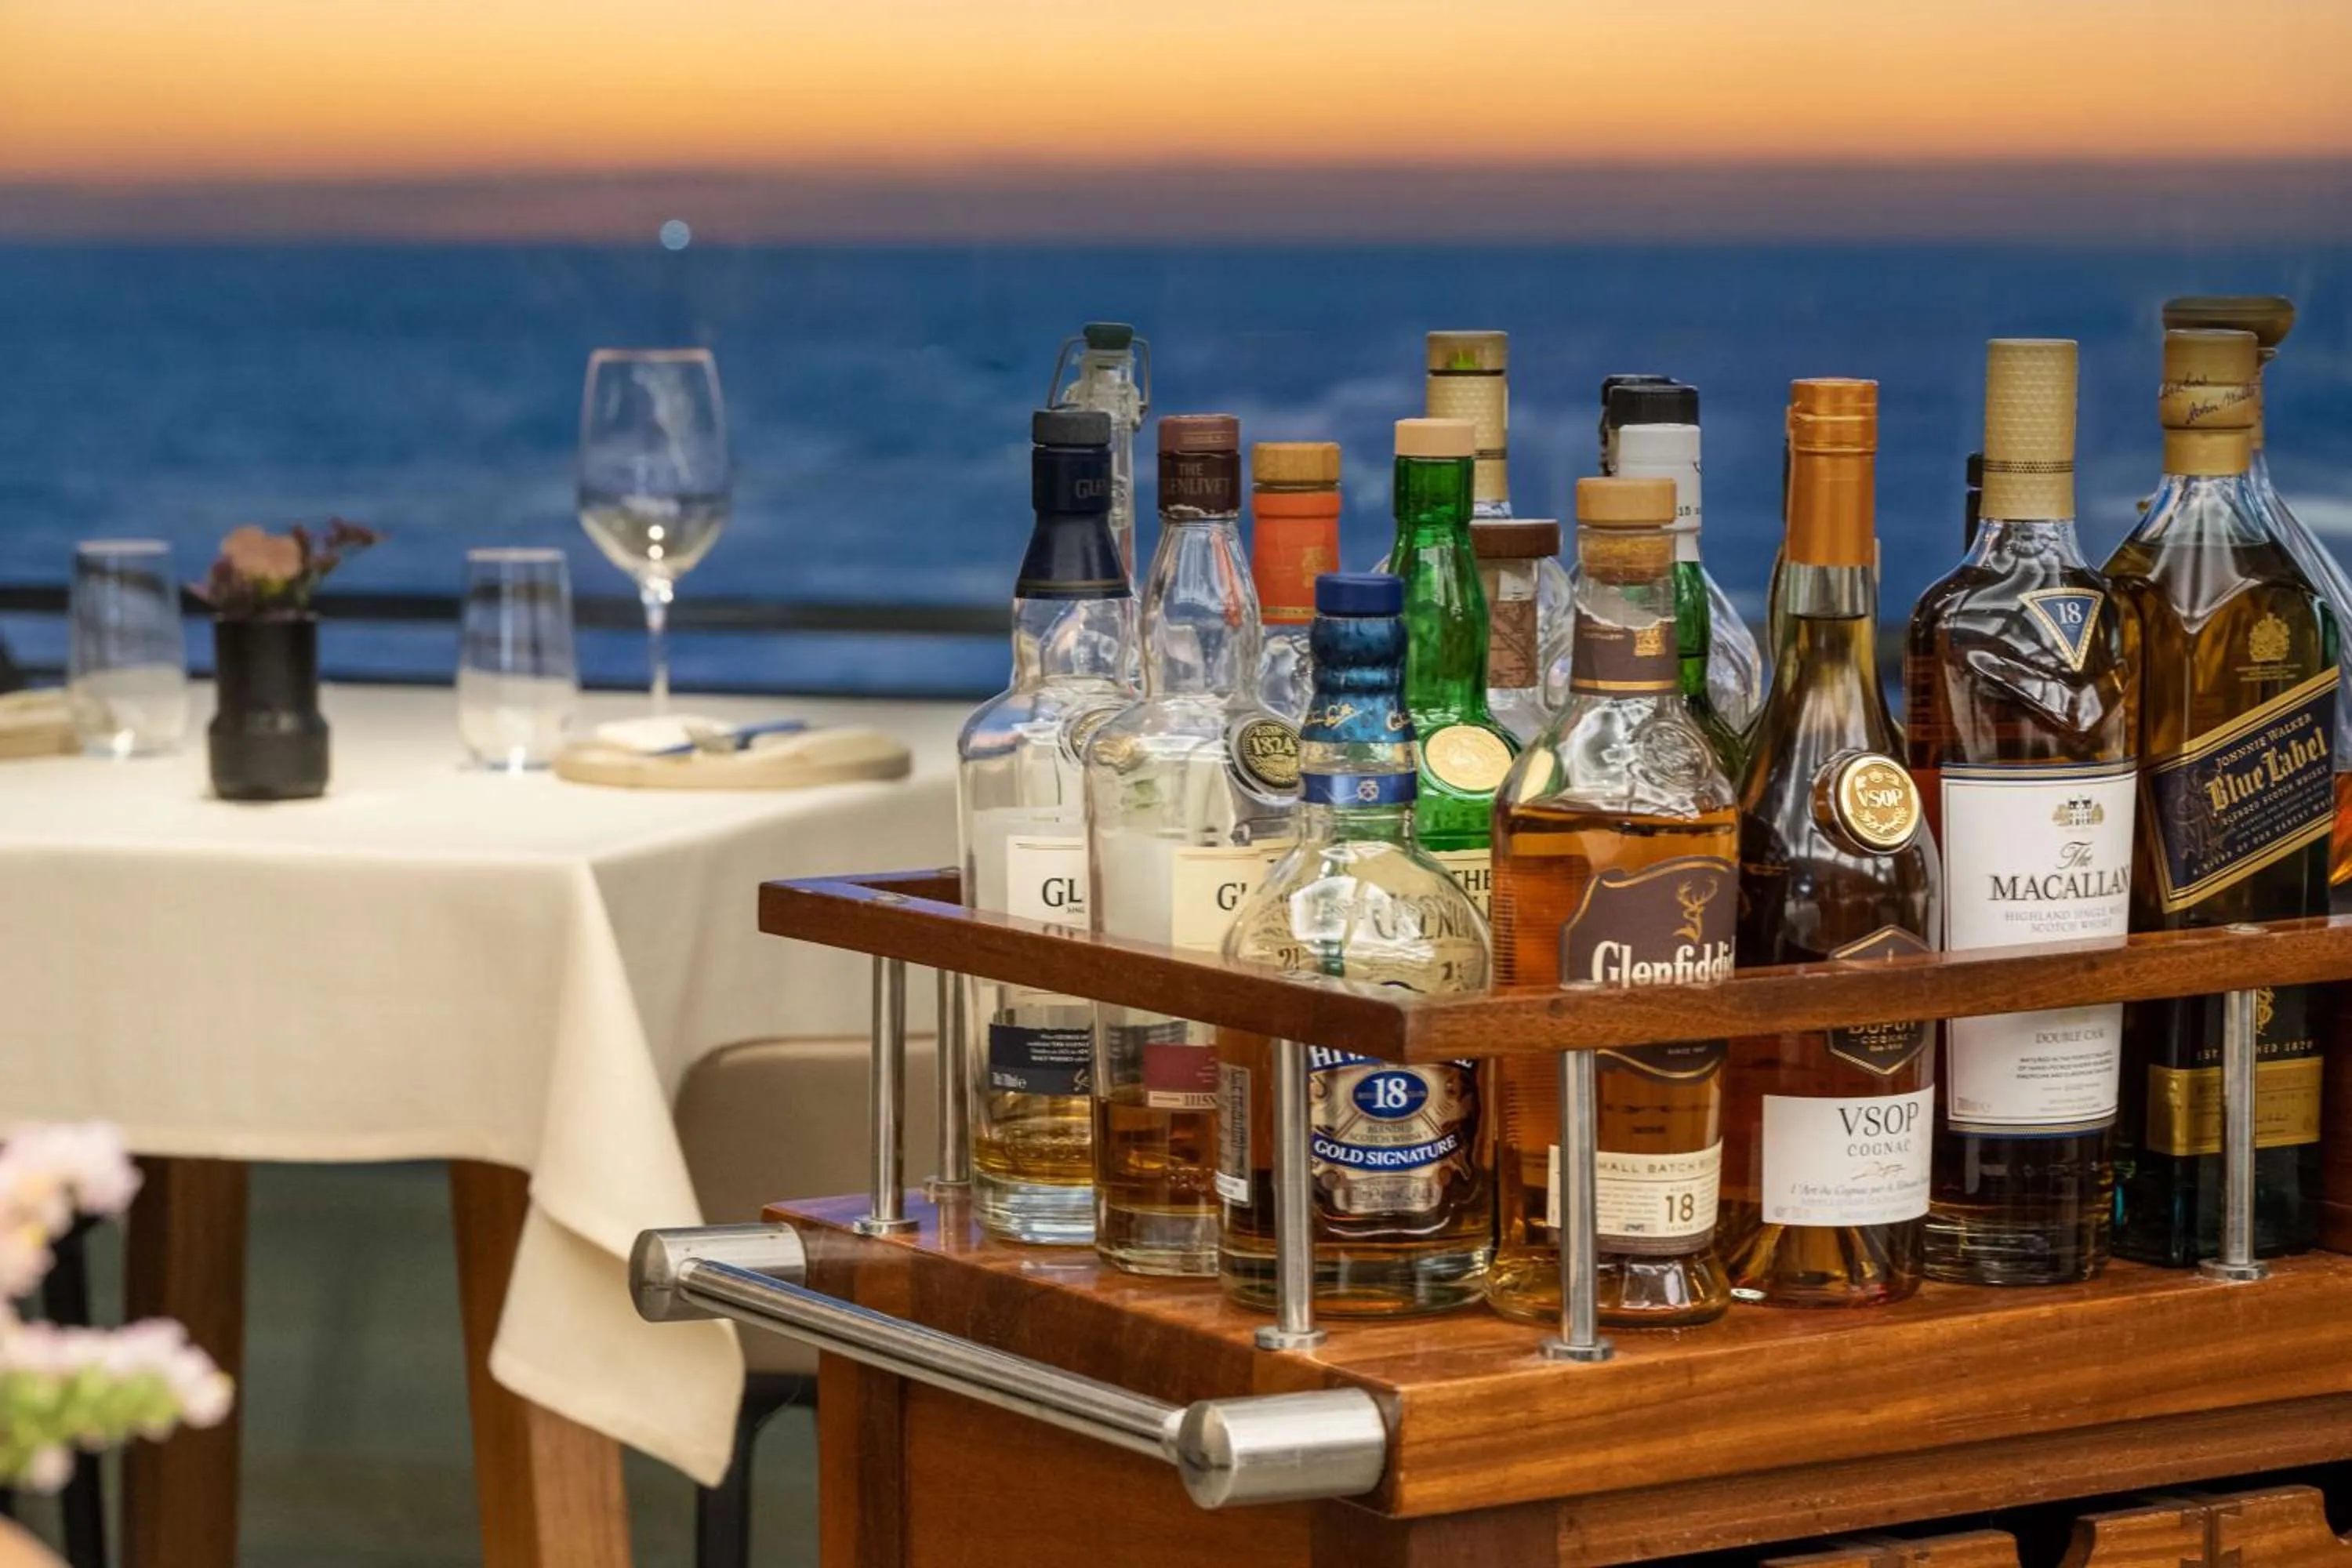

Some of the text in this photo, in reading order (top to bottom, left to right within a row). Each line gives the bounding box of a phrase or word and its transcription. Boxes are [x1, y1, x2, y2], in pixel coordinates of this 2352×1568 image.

[1178, 463, 1204, 477] THE
[2056, 601, 2082, 625] 18
[1251, 735, 1298, 756] 1824
[2204, 764, 2266, 811] Blue
[2259, 726, 2328, 783] Label
[1856, 788, 1904, 808] VSOP
[2055, 841, 2094, 869] The
[1450, 869, 1491, 891] HE
[1041, 877, 1083, 908] GL
[2004, 909, 2071, 922] HIGHLAND
[2035, 1030, 2080, 1044] DOUBLE
[1372, 1077, 1408, 1109] 18
[1837, 1101, 1920, 1137] VSOP
[1313, 1134, 1458, 1166] GOLD SIGNATURE
[1846, 1139, 1911, 1157] COGNAC
[1598, 1162, 1639, 1174] MALL
[1647, 1162, 1698, 1174] BATCH
[1664, 1192, 1695, 1223] 18
